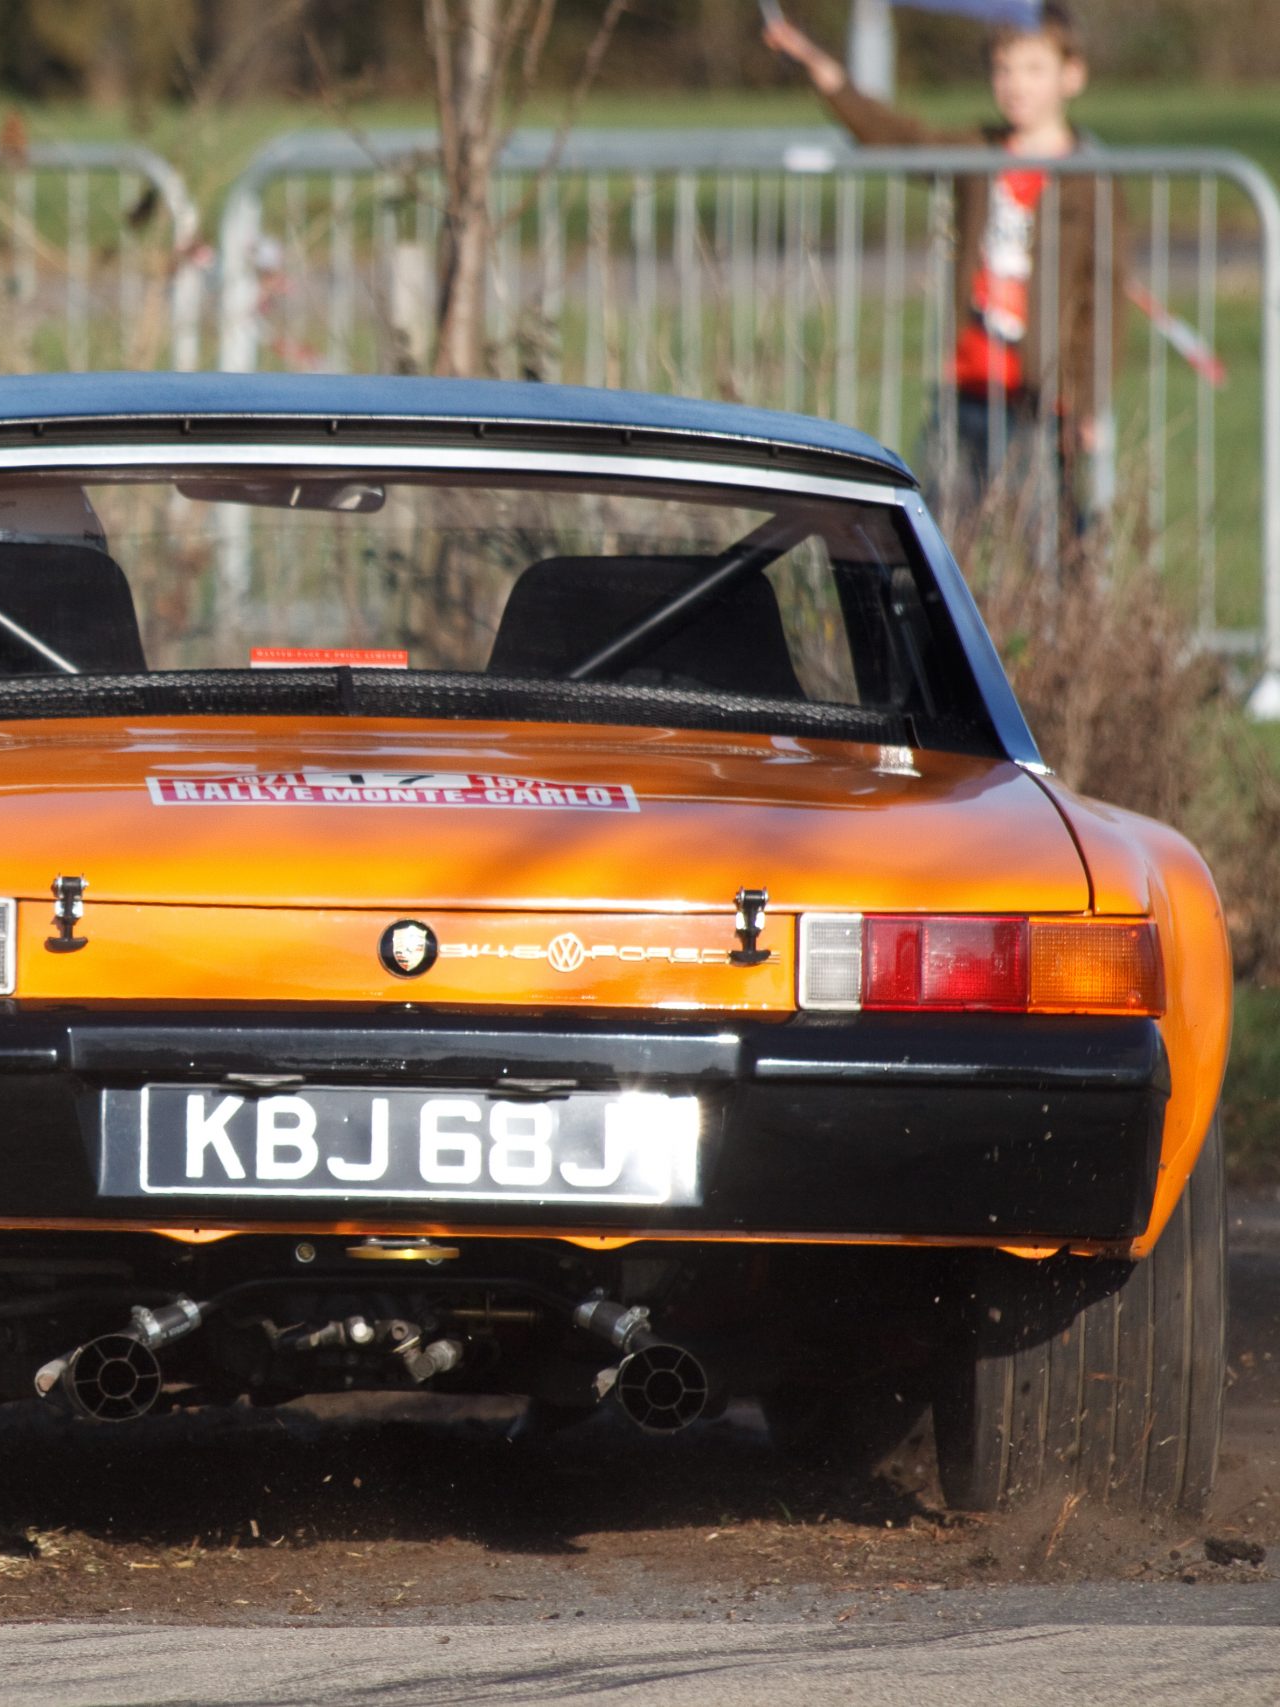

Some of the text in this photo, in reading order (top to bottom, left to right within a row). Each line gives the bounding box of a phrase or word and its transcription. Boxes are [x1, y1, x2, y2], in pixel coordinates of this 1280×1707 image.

[172, 781, 614, 807] RALLYE MONTE-CARLO
[591, 945, 782, 964] PORSC
[185, 1094, 624, 1187] KBJ 68J
